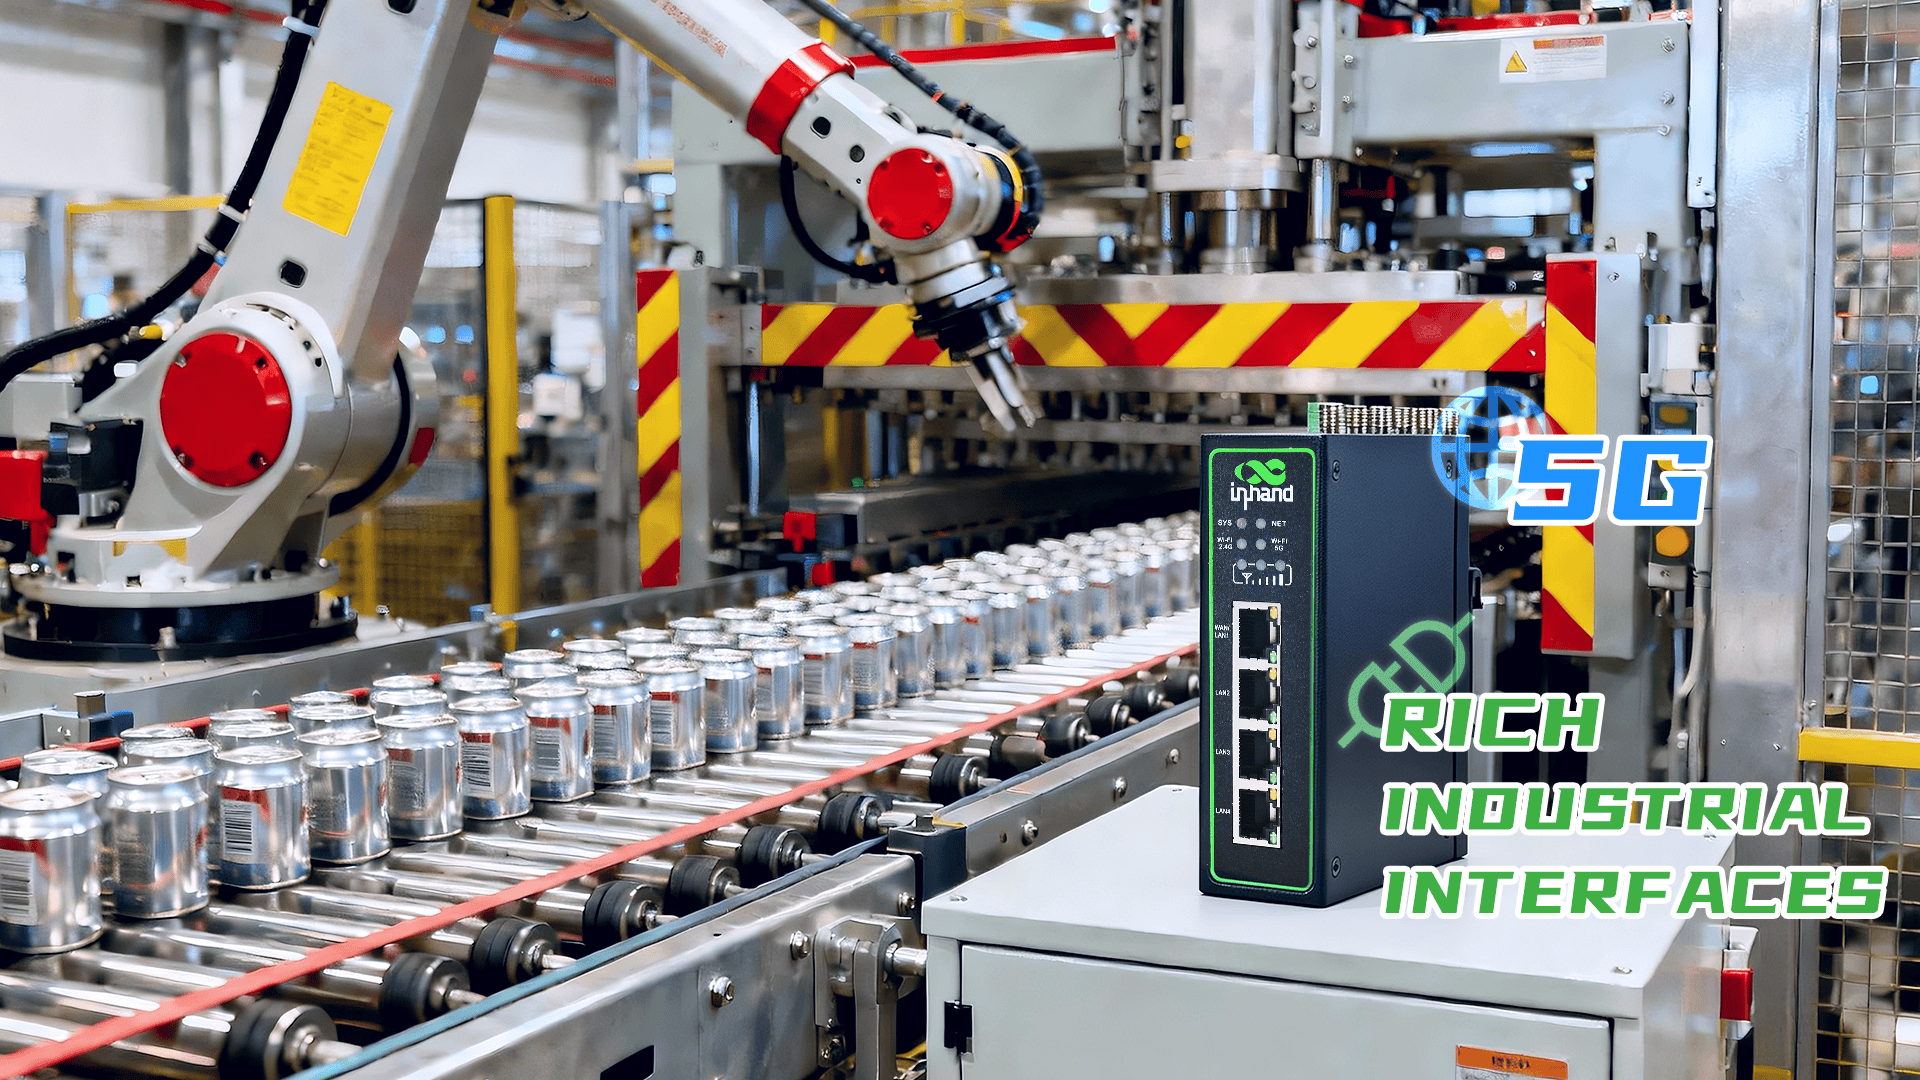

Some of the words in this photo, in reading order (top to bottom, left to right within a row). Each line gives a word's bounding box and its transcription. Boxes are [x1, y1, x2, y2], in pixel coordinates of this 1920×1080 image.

[1217, 519, 1233, 527] SYS
[1215, 689, 1231, 697] LAN2
[1215, 748, 1231, 756] LAN3
[1215, 807, 1231, 815] LAN4
